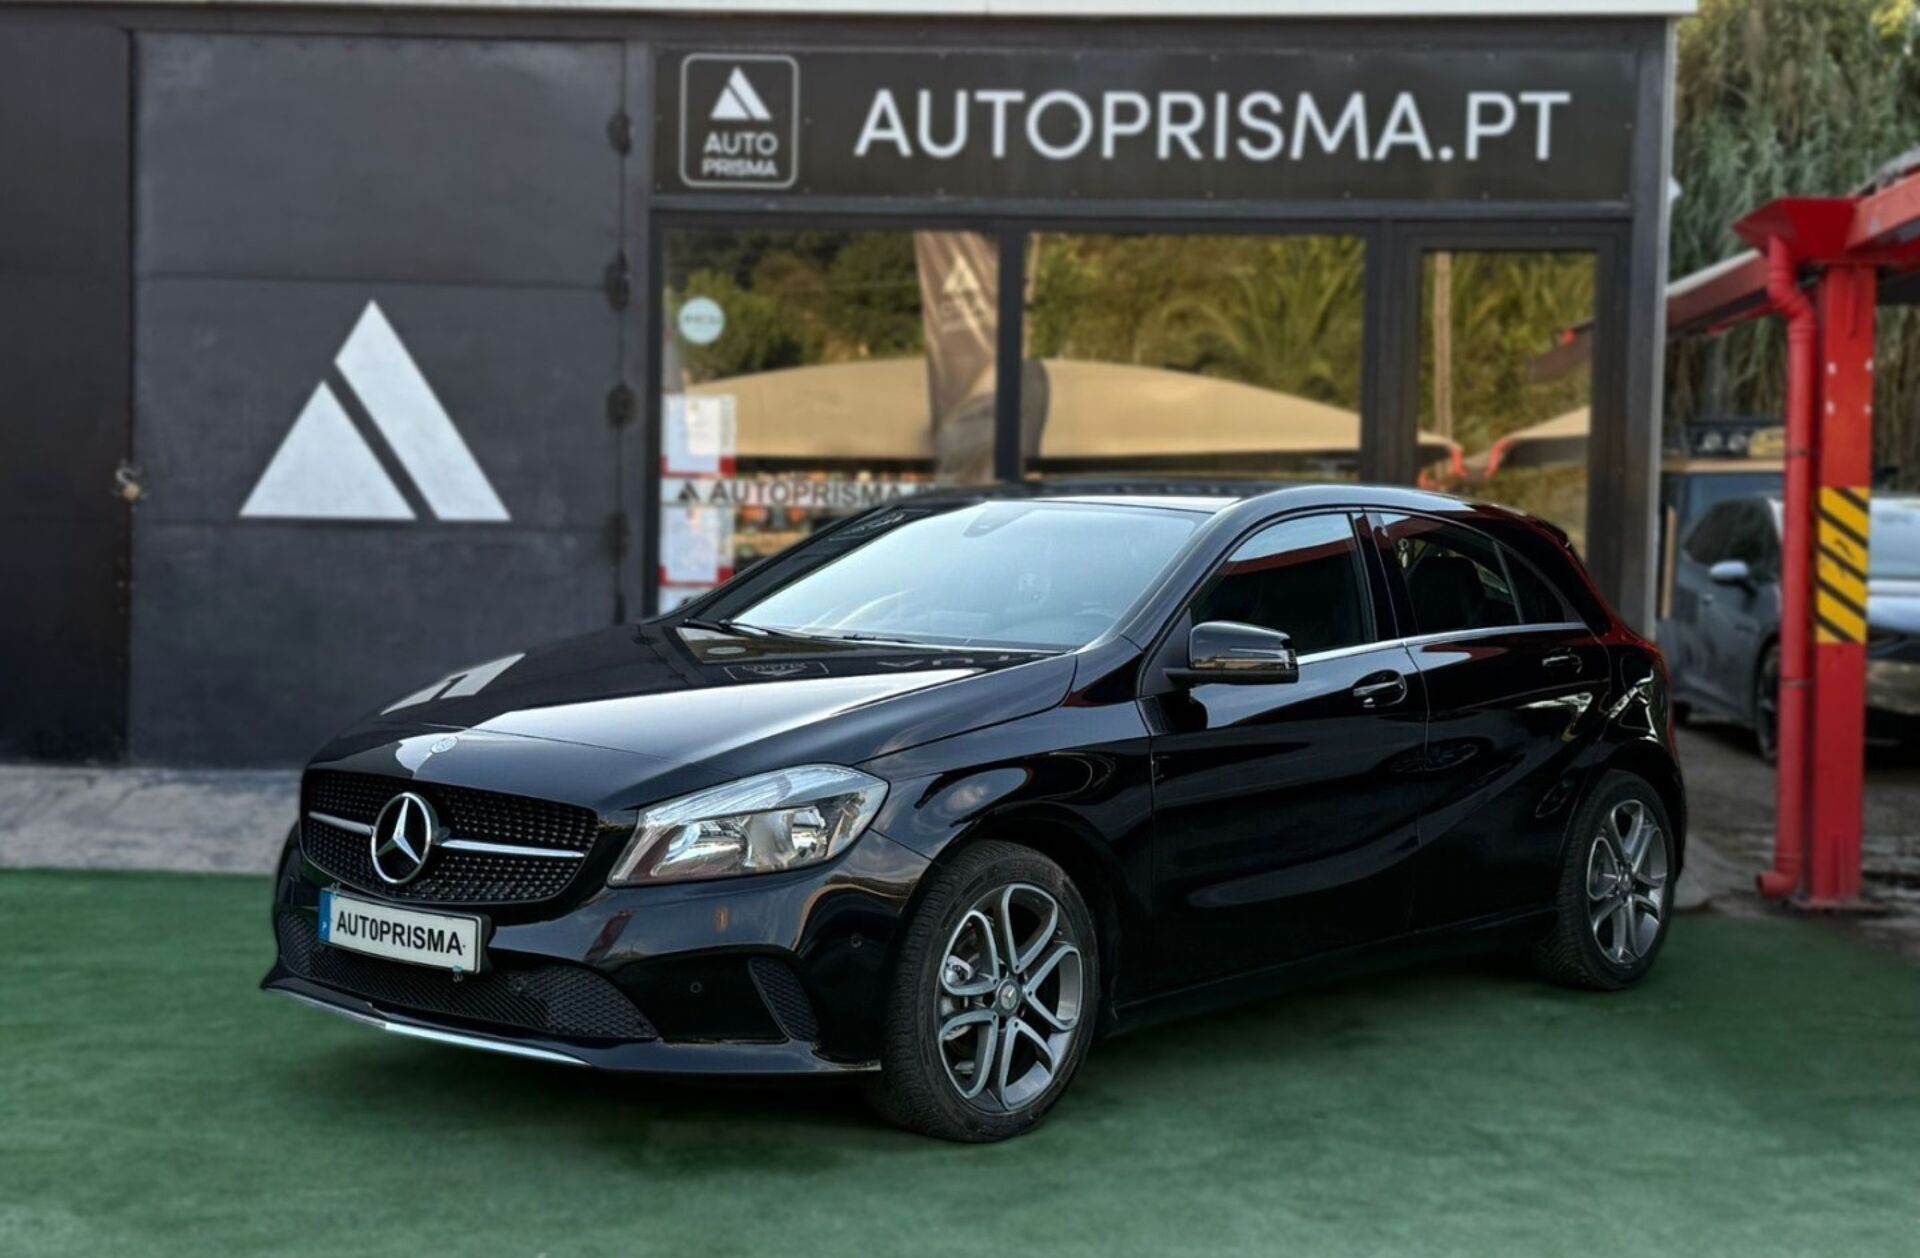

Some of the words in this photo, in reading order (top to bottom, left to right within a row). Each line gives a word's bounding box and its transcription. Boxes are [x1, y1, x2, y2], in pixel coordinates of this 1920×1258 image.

[703, 131, 778, 155] AUTO
[854, 89, 1571, 162] AUTOPRISMA.PT
[702, 158, 778, 176] PRISMA
[336, 910, 463, 956] AUTOPRISMA
